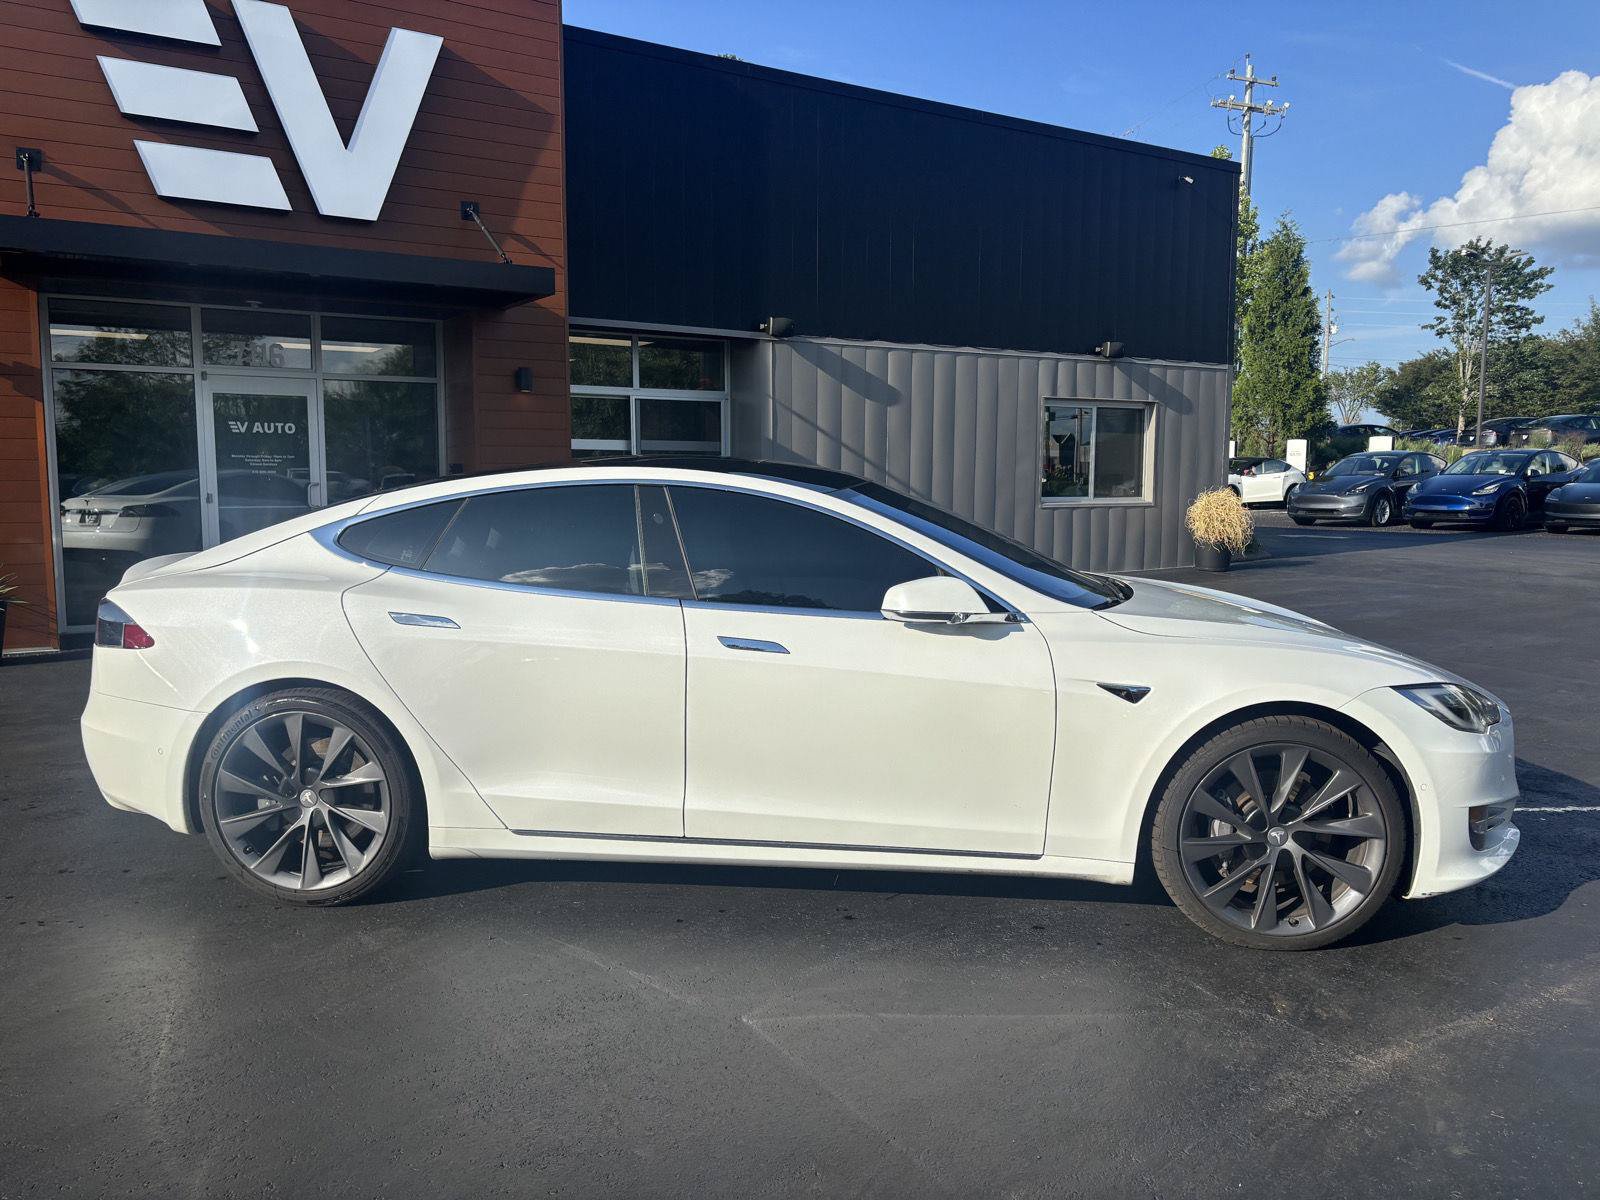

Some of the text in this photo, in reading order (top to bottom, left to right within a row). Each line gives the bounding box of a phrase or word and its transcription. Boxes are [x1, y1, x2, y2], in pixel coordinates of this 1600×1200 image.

[70, 0, 444, 222] EV
[228, 421, 296, 434] EV AUTO
